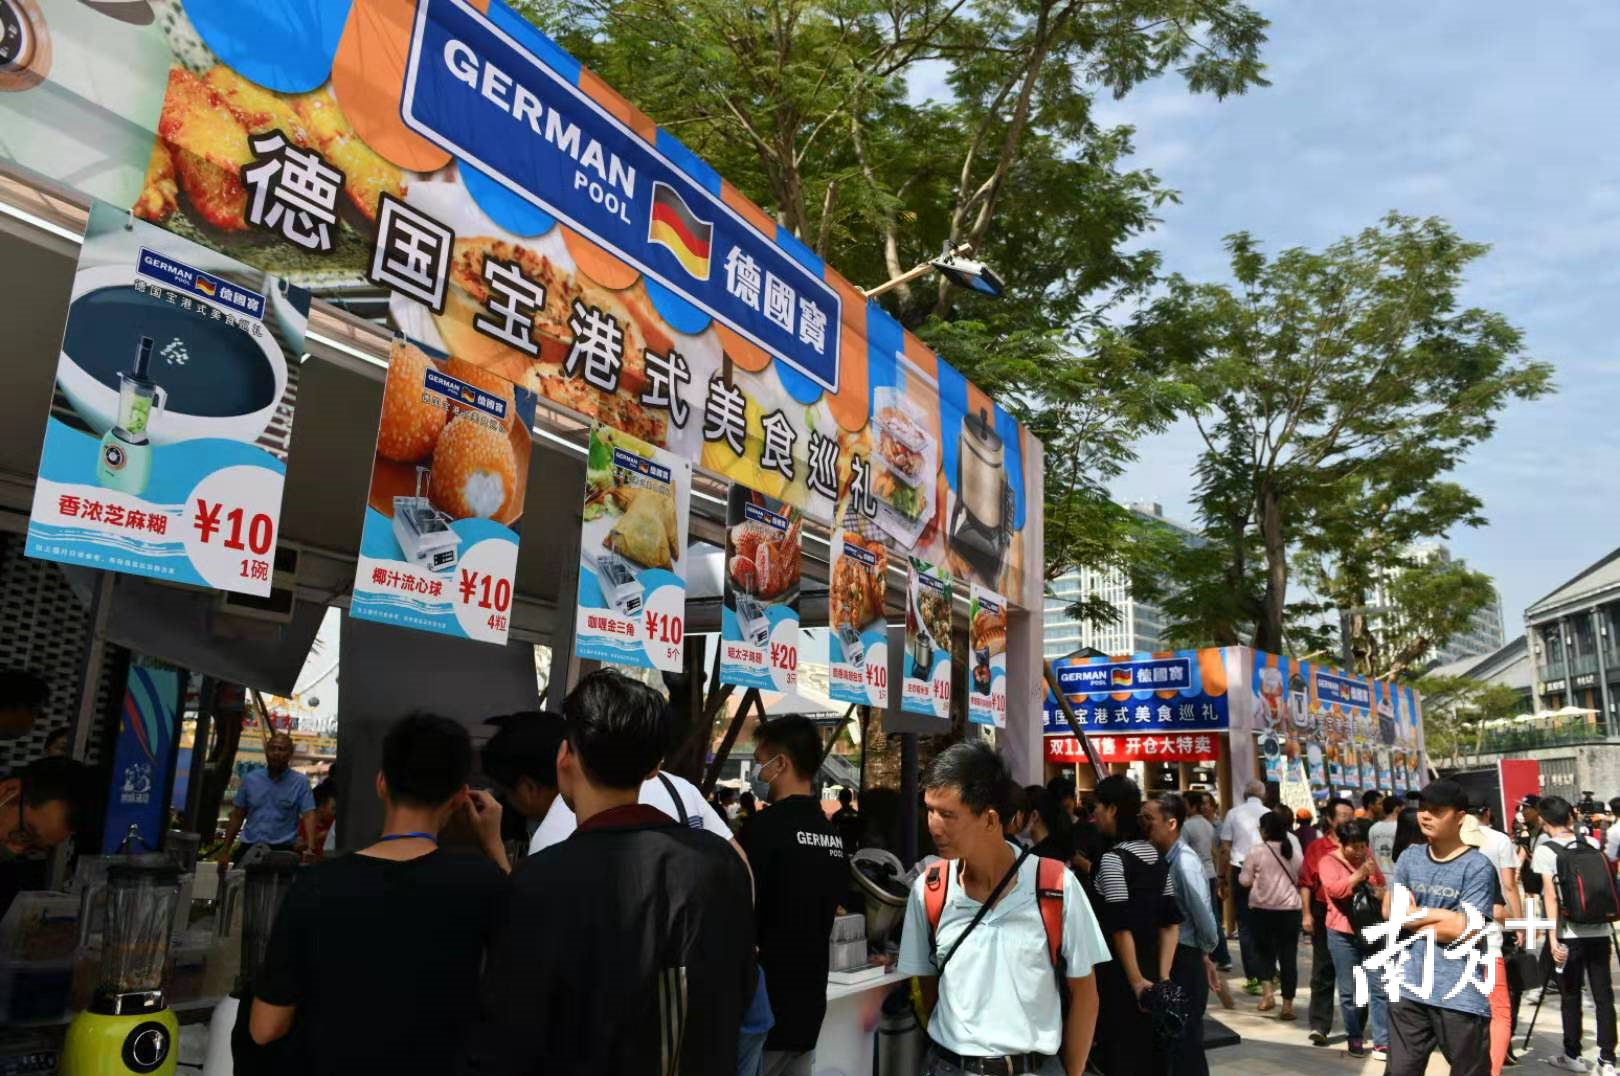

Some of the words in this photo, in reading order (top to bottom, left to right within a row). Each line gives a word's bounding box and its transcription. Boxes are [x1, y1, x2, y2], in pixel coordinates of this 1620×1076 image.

[444, 39, 636, 200] GERMAN
[573, 169, 631, 224] POOL
[144, 255, 193, 280] GERMAN
[723, 245, 828, 355] 德國寶
[243, 131, 878, 518] 德国宝港式美食巡礼
[428, 373, 460, 391] GERMAN
[57, 494, 168, 536] 香浓芝麻糊
[193, 498, 273, 556] ¥10
[240, 559, 268, 582] 1碗
[372, 567, 443, 597] 椰汁流心球
[459, 568, 511, 612] ¥10
[487, 614, 507, 631] 4粒
[646, 610, 682, 645] ¥10
[666, 648, 680, 662] 5个
[770, 641, 797, 671] ¥20
[866, 664, 887, 688] ¥10
[1061, 671, 1107, 682] GERMAN
[1125, 736, 1212, 757] 开仓大特卖
[796, 831, 843, 849] GERMAN
